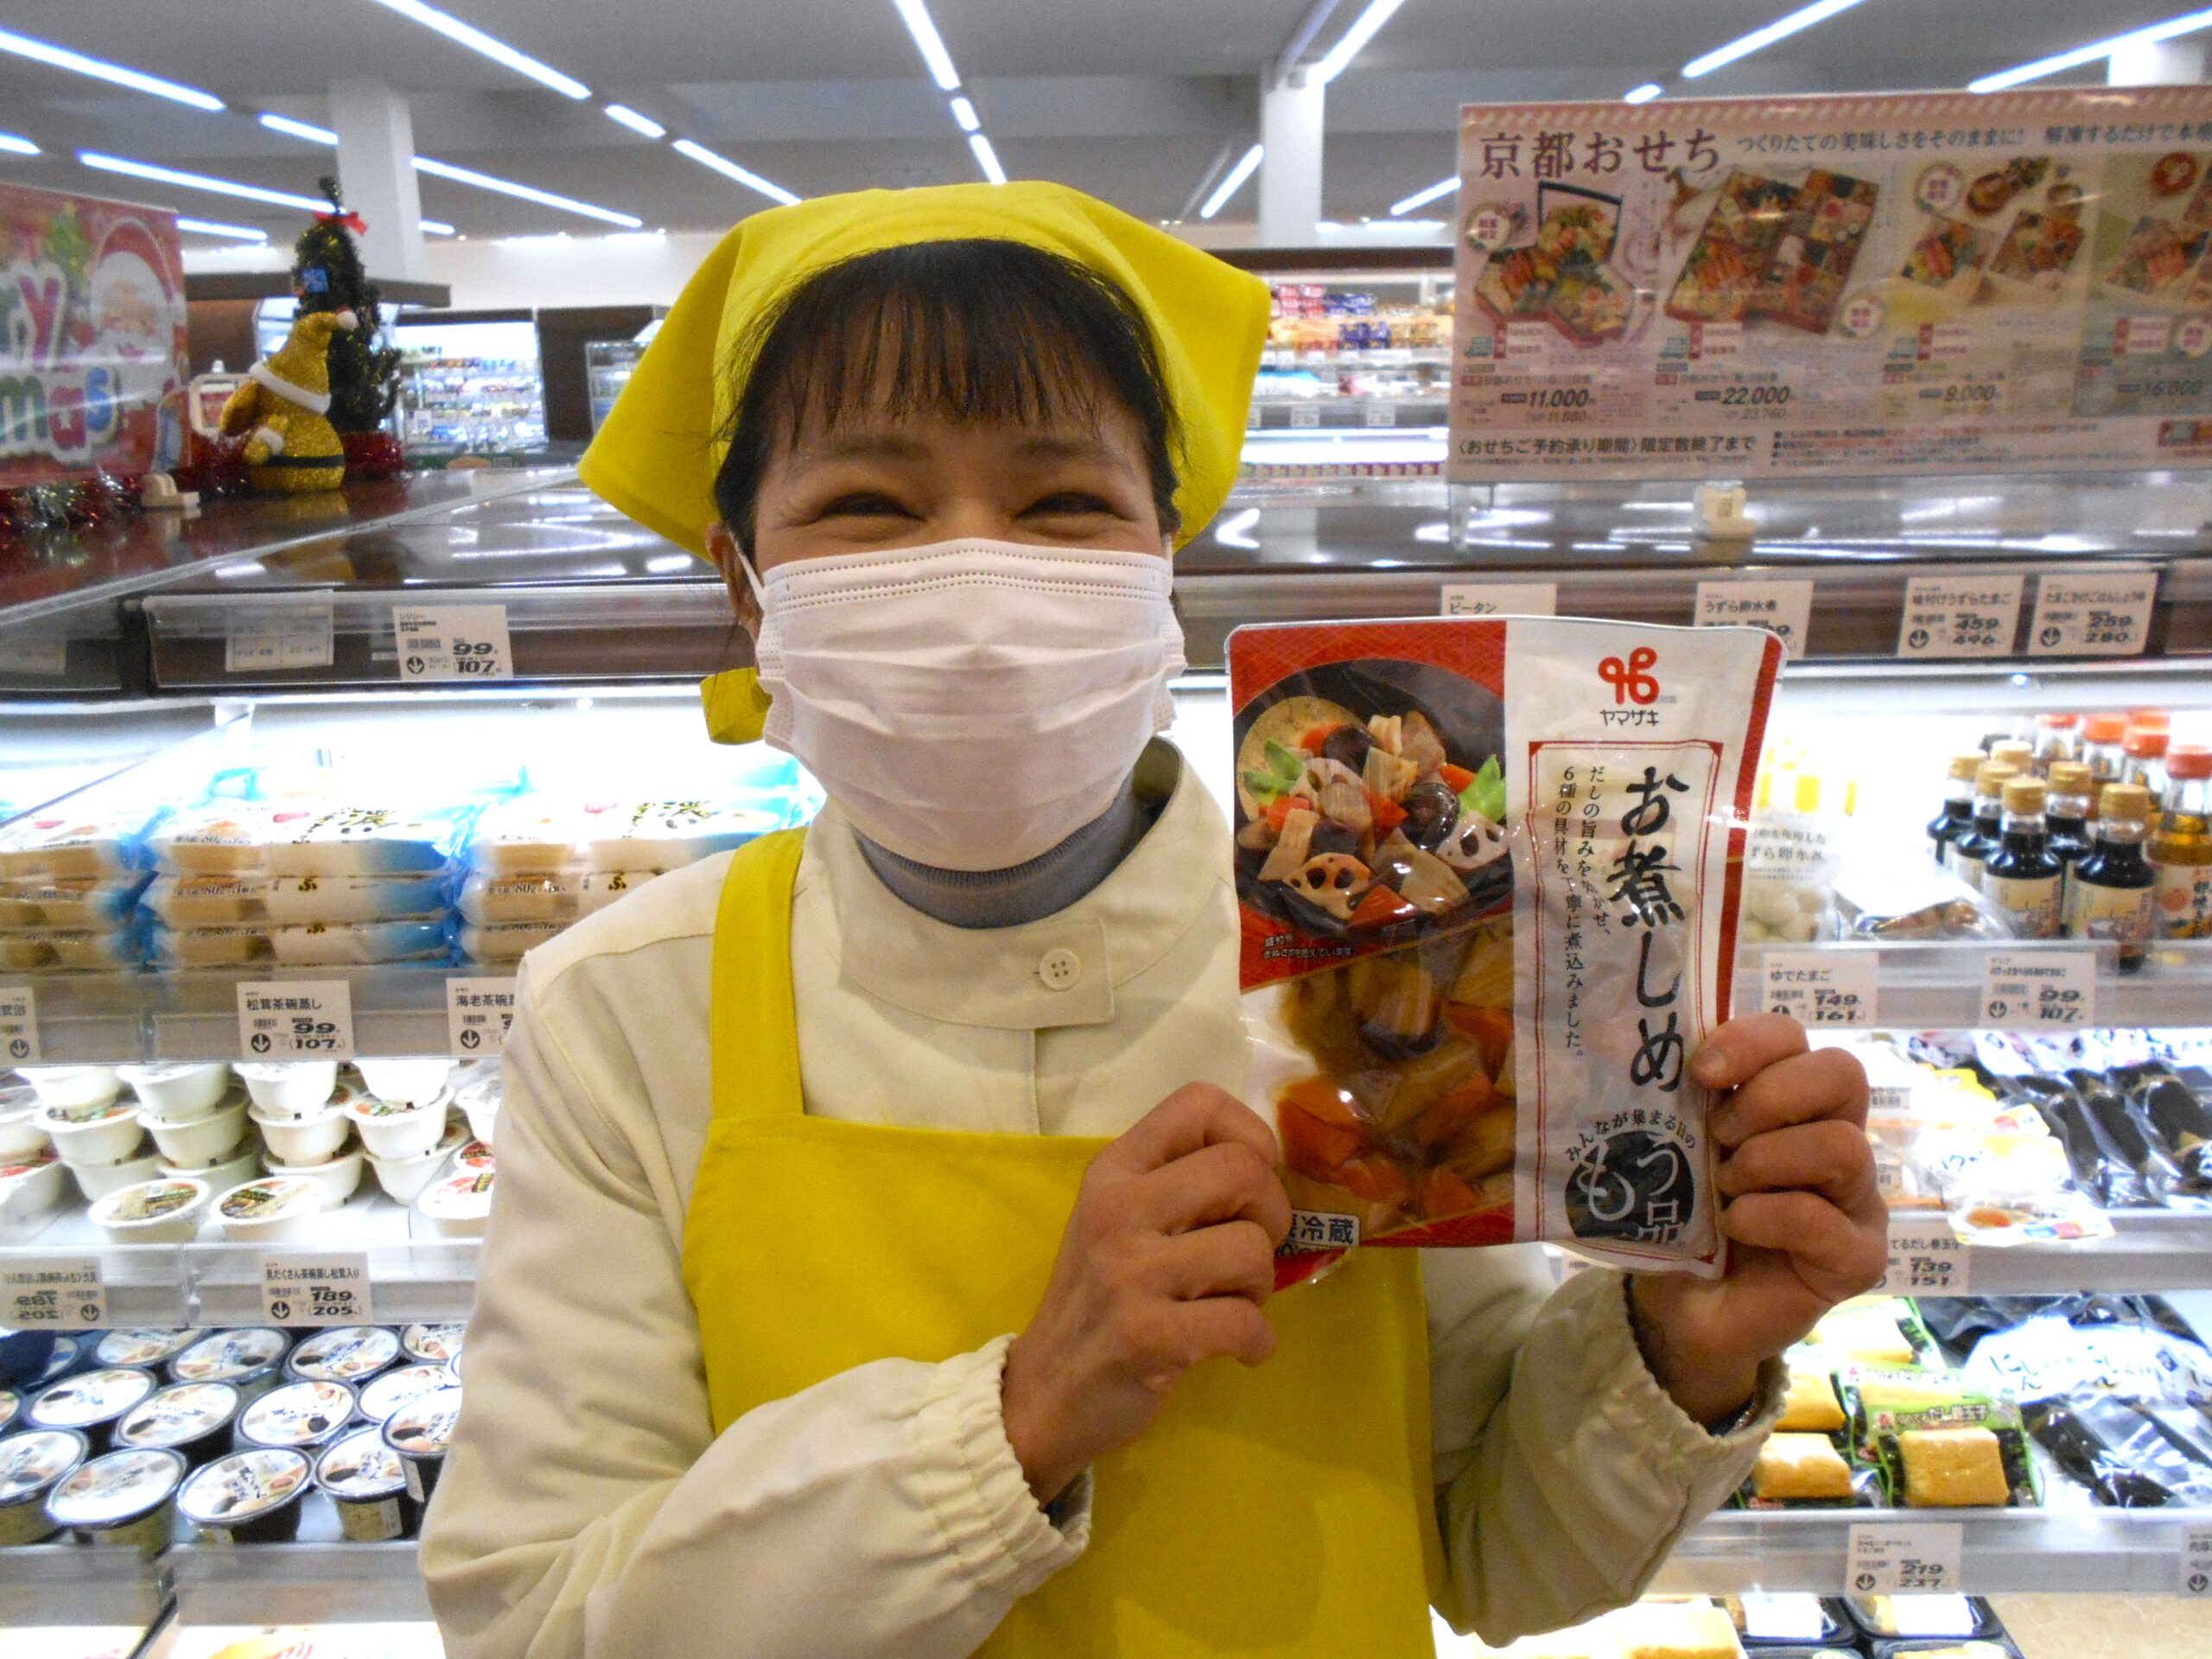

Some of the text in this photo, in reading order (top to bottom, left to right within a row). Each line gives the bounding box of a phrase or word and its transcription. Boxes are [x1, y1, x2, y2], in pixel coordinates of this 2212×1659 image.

[1478, 127, 1720, 180] 京都おせち
[1705, 598, 1778, 613] うずら卵水煮
[1599, 709, 1660, 727] ヤマザキ
[1606, 766, 1690, 1093] お煮しめ
[1770, 969, 1831, 982] ゆでたまご
[1815, 993, 1859, 1006] 149
[2038, 988, 2082, 1002] 99
[245, 997, 322, 1012] 松茸茶碗蒸し
[292, 1021, 337, 1034] 99
[1565, 1108, 1696, 1162] みんなが集まる日の
[312, 1290, 354, 1302] 189
[1900, 1563, 1945, 1575] 219
